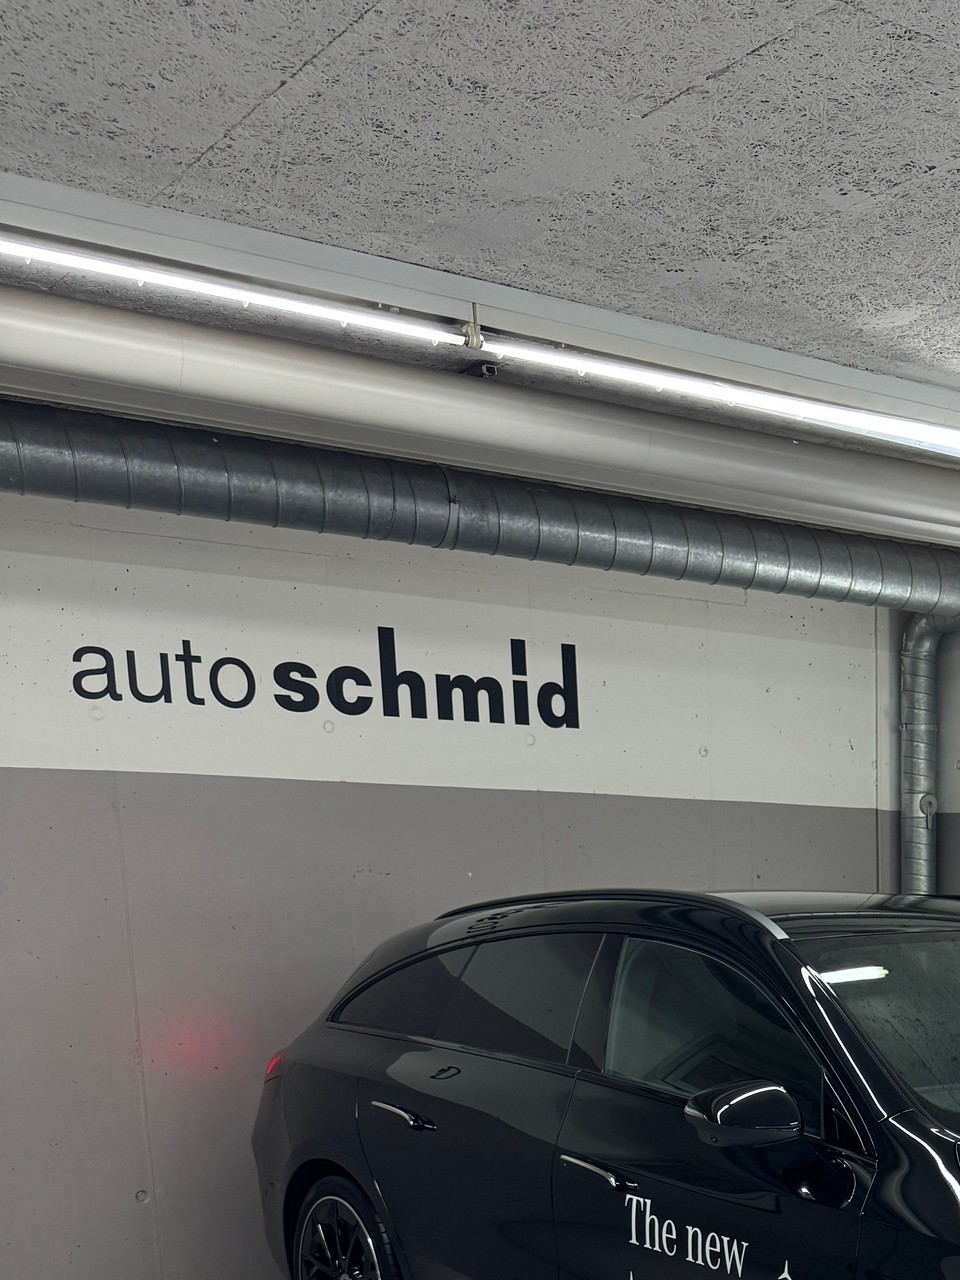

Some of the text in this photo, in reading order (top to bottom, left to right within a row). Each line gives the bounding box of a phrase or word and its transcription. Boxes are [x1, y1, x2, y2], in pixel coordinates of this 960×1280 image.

[72, 626, 581, 730] auto schmid
[625, 1193, 750, 1279] The new
